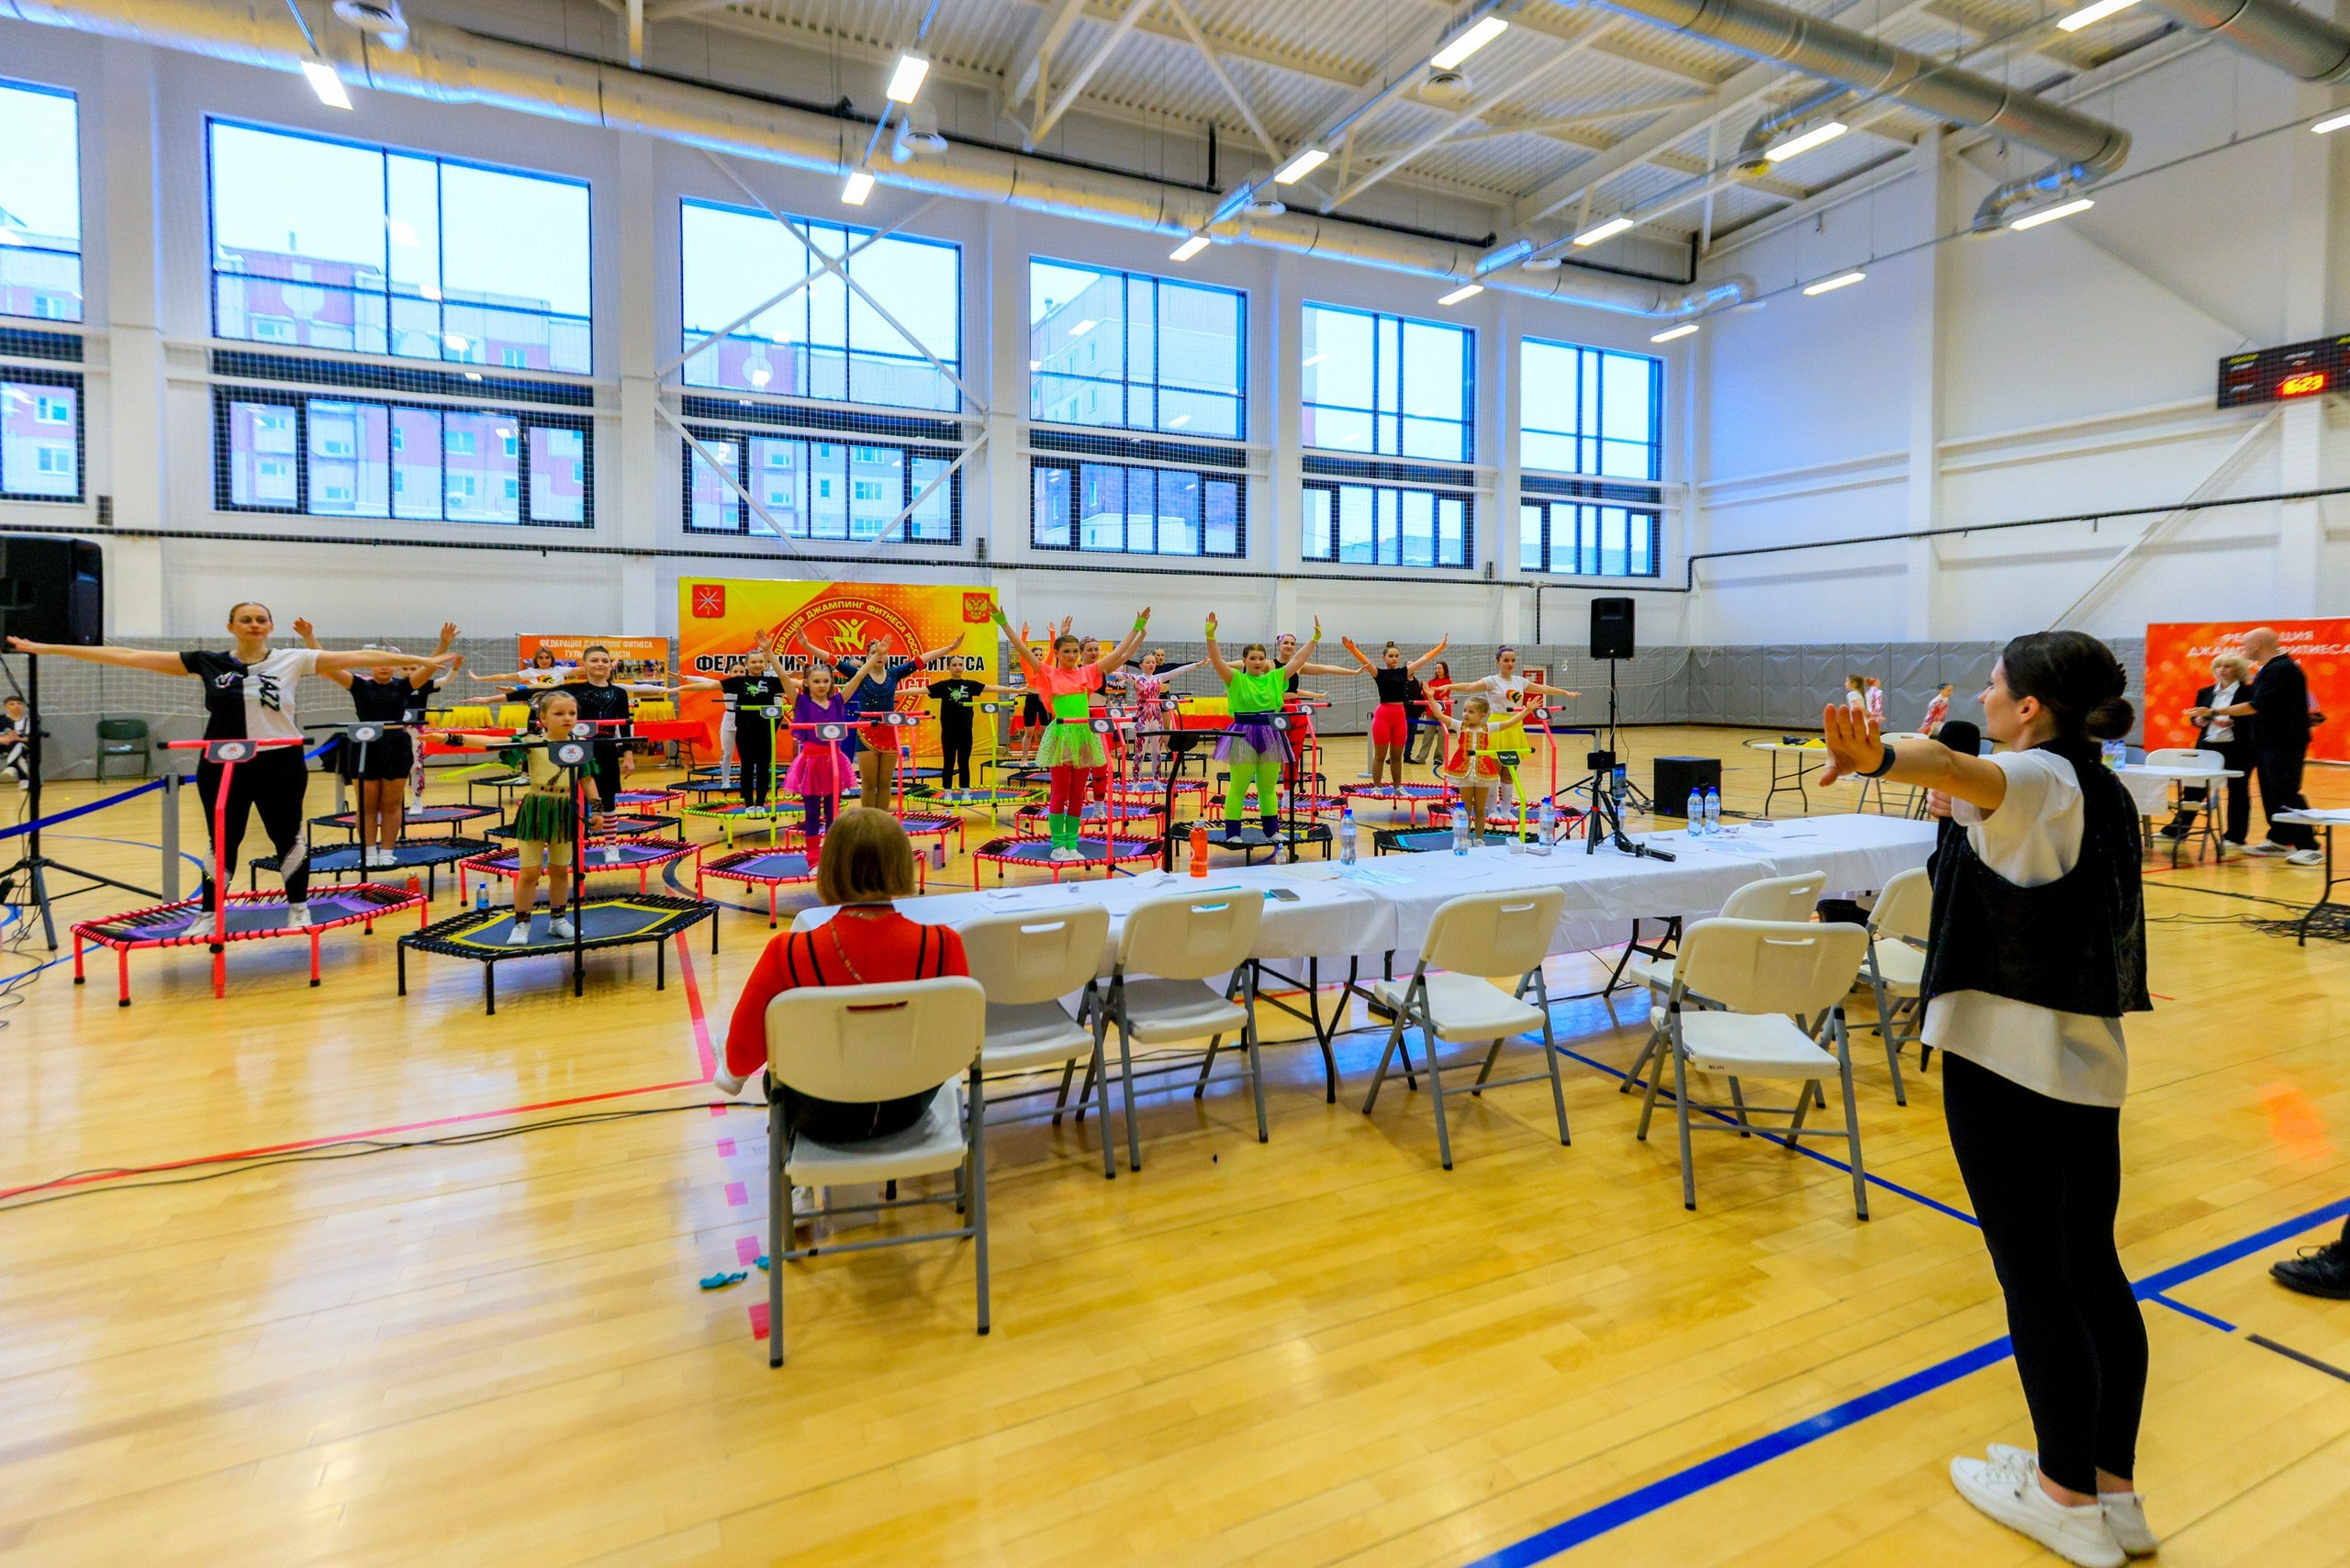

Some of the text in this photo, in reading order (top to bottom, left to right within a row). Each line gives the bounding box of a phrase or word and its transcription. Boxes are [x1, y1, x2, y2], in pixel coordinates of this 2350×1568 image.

[539, 639, 582, 648] ФЕДЕРАЦИЯ
[806, 600, 865, 621] ДЖАМПИНГ
[867, 605, 906, 633] ФИТНЕСА
[904, 632, 920, 655] РОСС
